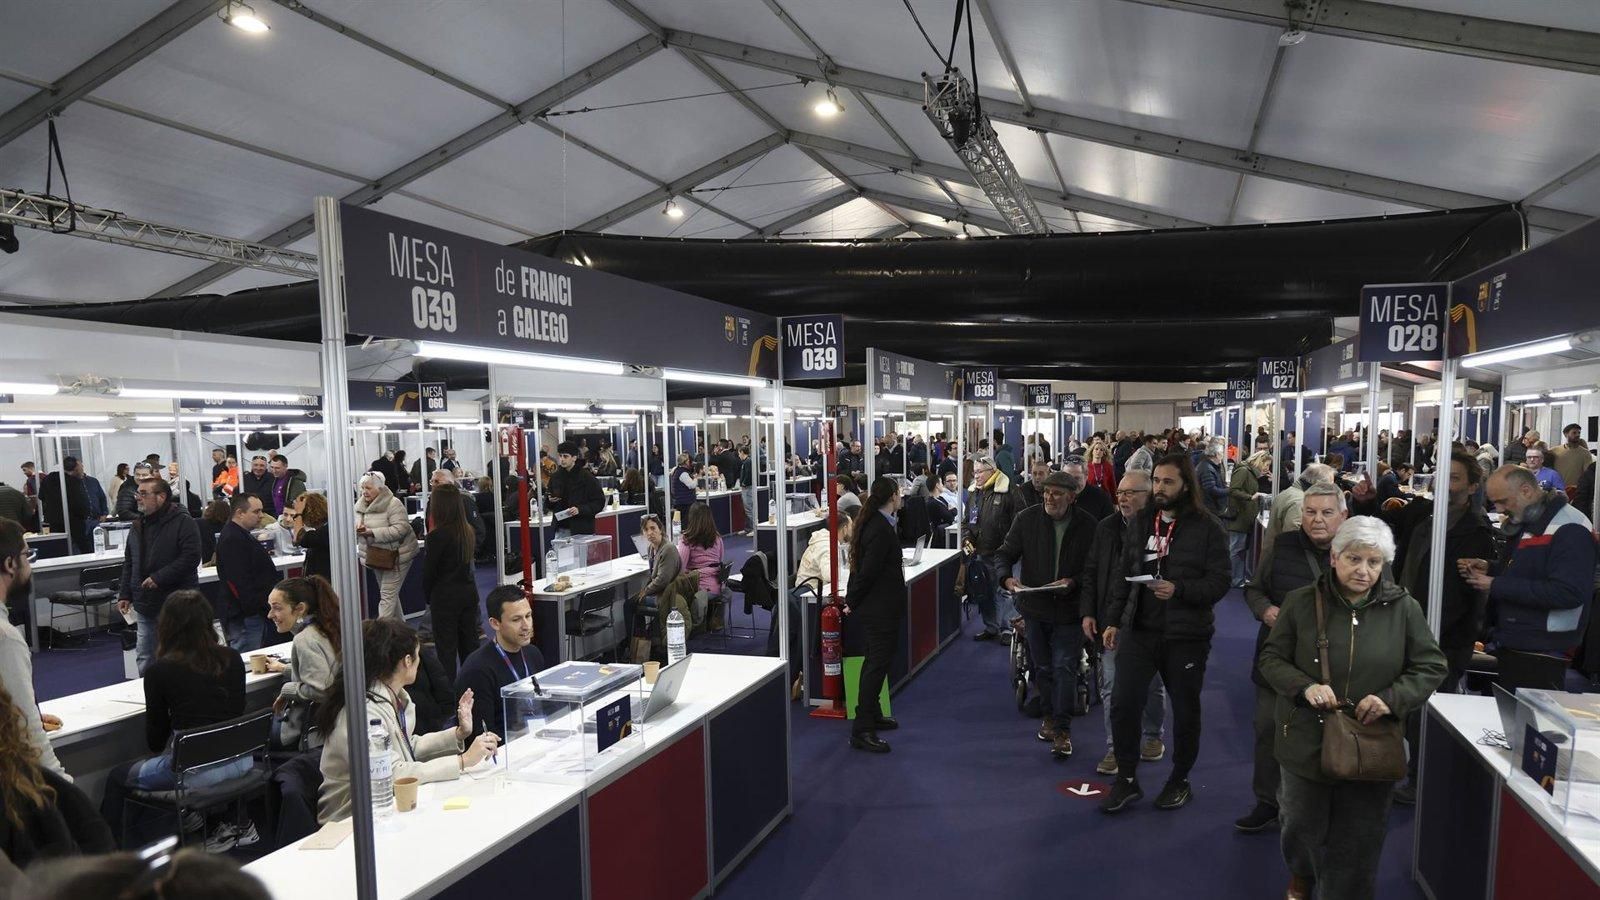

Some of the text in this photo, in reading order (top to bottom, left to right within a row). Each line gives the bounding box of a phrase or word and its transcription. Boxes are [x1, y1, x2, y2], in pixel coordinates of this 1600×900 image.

[388, 232, 455, 288] MESA
[495, 258, 573, 307] de FRANCI
[410, 286, 457, 333] 039
[1370, 294, 1438, 322] MESA
[497, 304, 569, 345] a GALEGO
[787, 321, 837, 347] MESA
[1387, 323, 1438, 352] 028
[802, 346, 838, 371] 039
[1262, 360, 1295, 375] MESA
[966, 371, 994, 384] MESA
[1272, 375, 1295, 389] 027
[422, 386, 444, 397] MESA
[974, 384, 994, 397] 038
[1029, 385, 1050, 395] MESA
[1229, 380, 1251, 390] MESA
[1035, 395, 1049, 404] 037
[1059, 394, 1075, 402] MESA
[1209, 390, 1226, 399] MESA
[1235, 389, 1251, 399] 026
[428, 397, 444, 409] 060
